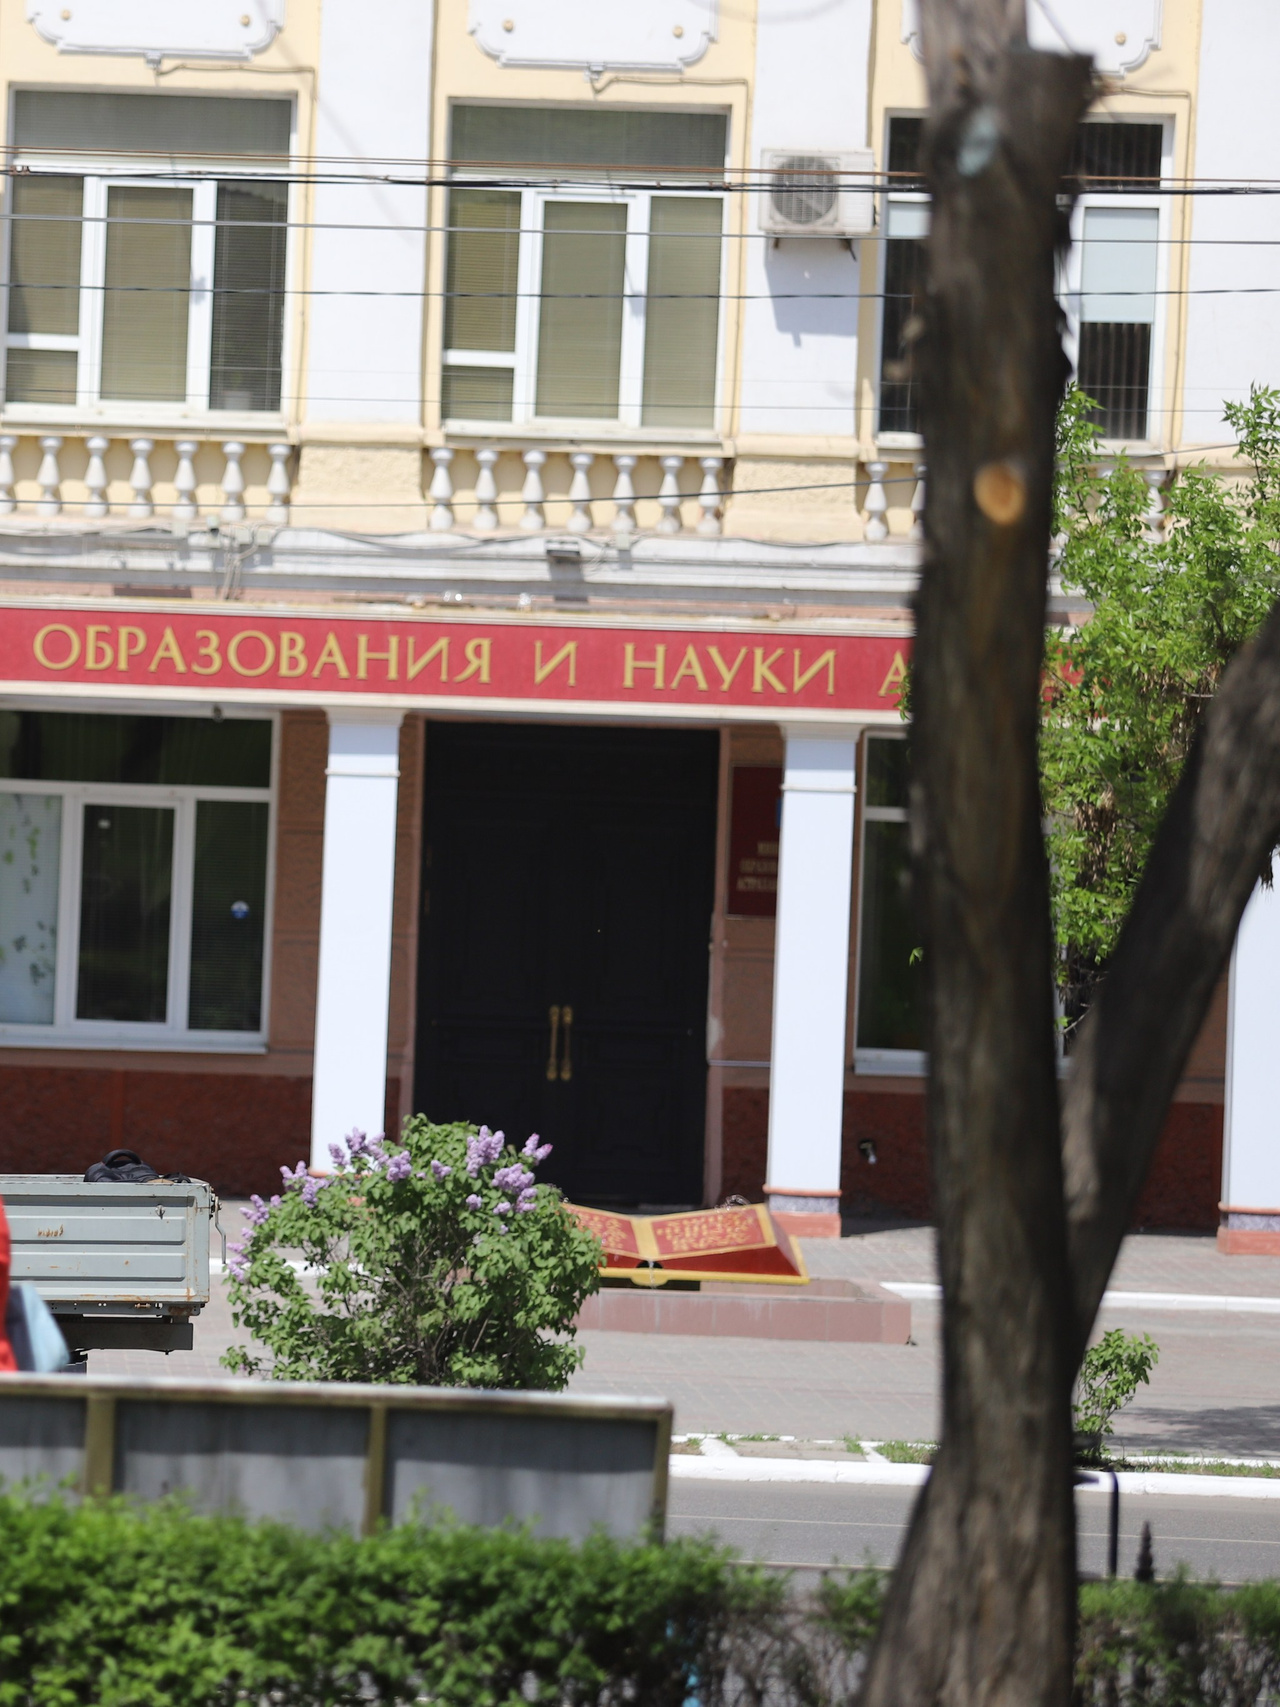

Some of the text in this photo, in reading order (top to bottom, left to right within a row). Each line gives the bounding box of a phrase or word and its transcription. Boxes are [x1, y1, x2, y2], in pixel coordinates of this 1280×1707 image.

[33, 623, 492, 684] ОБРАЗОВАНИЯ
[534, 640, 578, 686] И
[623, 642, 837, 695] НАУКИ
